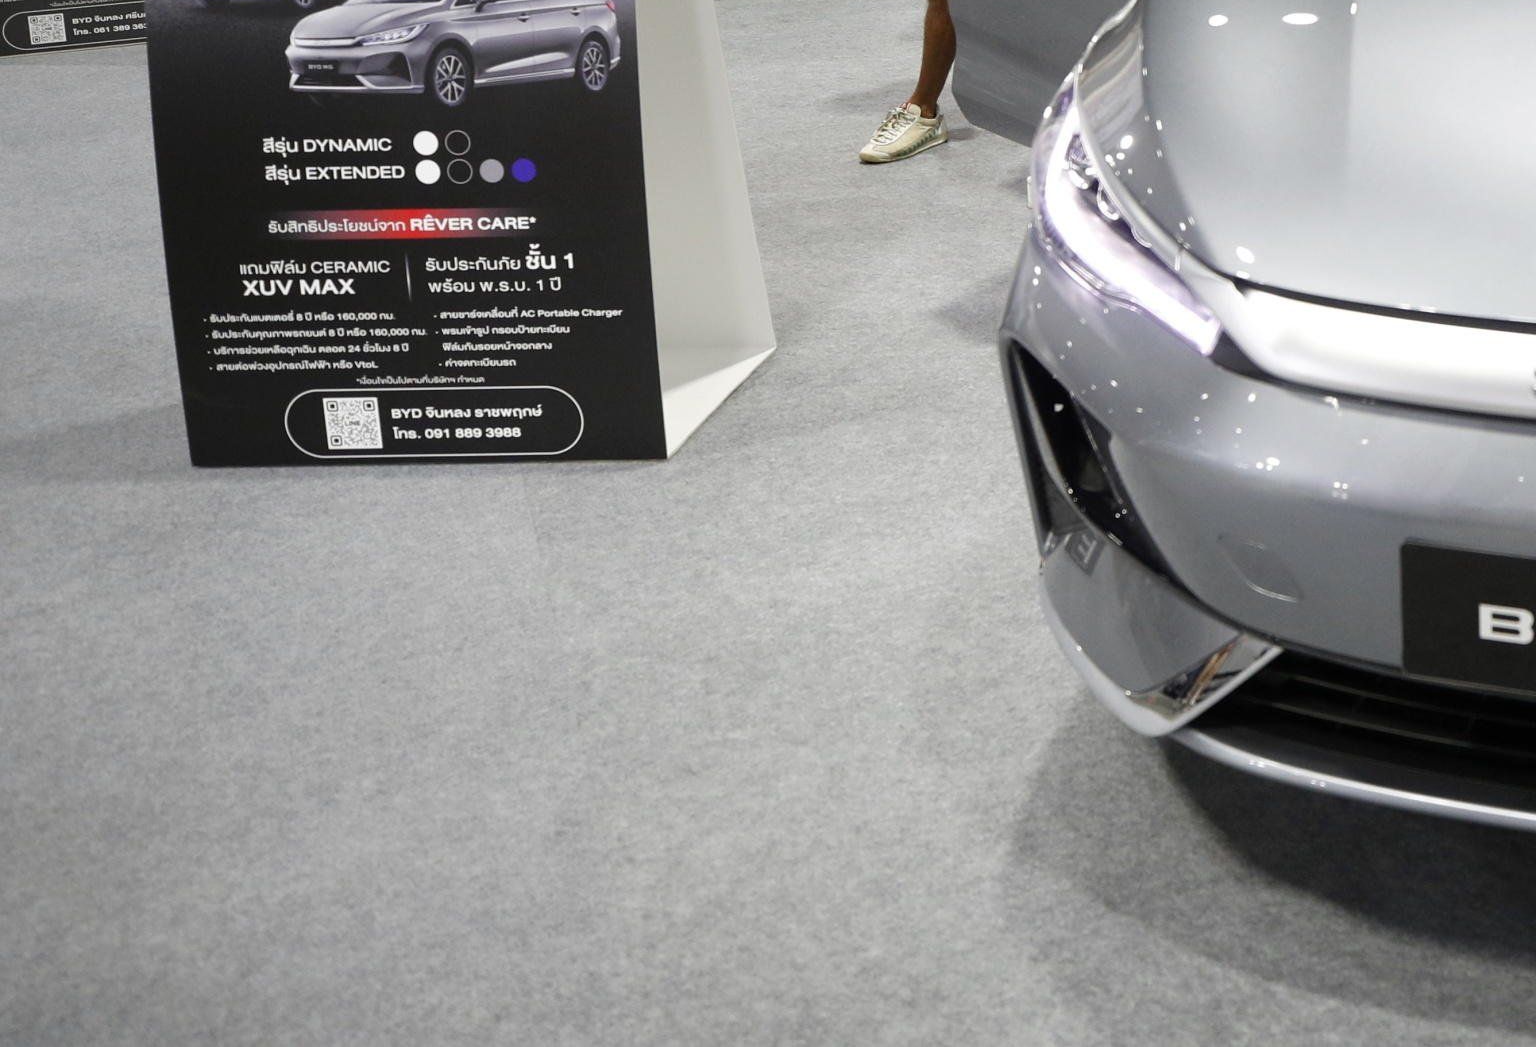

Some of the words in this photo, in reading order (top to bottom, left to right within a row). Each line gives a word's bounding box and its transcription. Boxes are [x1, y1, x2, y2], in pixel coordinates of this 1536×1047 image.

[263, 136, 298, 158] สีรุ่น
[303, 138, 392, 152] DYNAMIC
[265, 164, 300, 185] สีรุ่น
[305, 166, 405, 180] EXTENDED
[410, 214, 473, 231] RÊVER
[426, 257, 521, 272] รับประกันภัย
[526, 243, 557, 270] ชั้น
[563, 253, 575, 269] 1
[311, 260, 390, 274] CERAMIC
[243, 279, 293, 296] XUV
[300, 278, 356, 295] MAX
[428, 277, 475, 293] พร้อม
[536, 280, 544, 291] 1
[549, 277, 561, 291] ปี
[520, 310, 535, 318] AC
[537, 309, 579, 318] Portable
[581, 308, 623, 319] Charger
[391, 408, 422, 419] BYD
[424, 428, 450, 439] 091
[455, 427, 482, 438] 889
